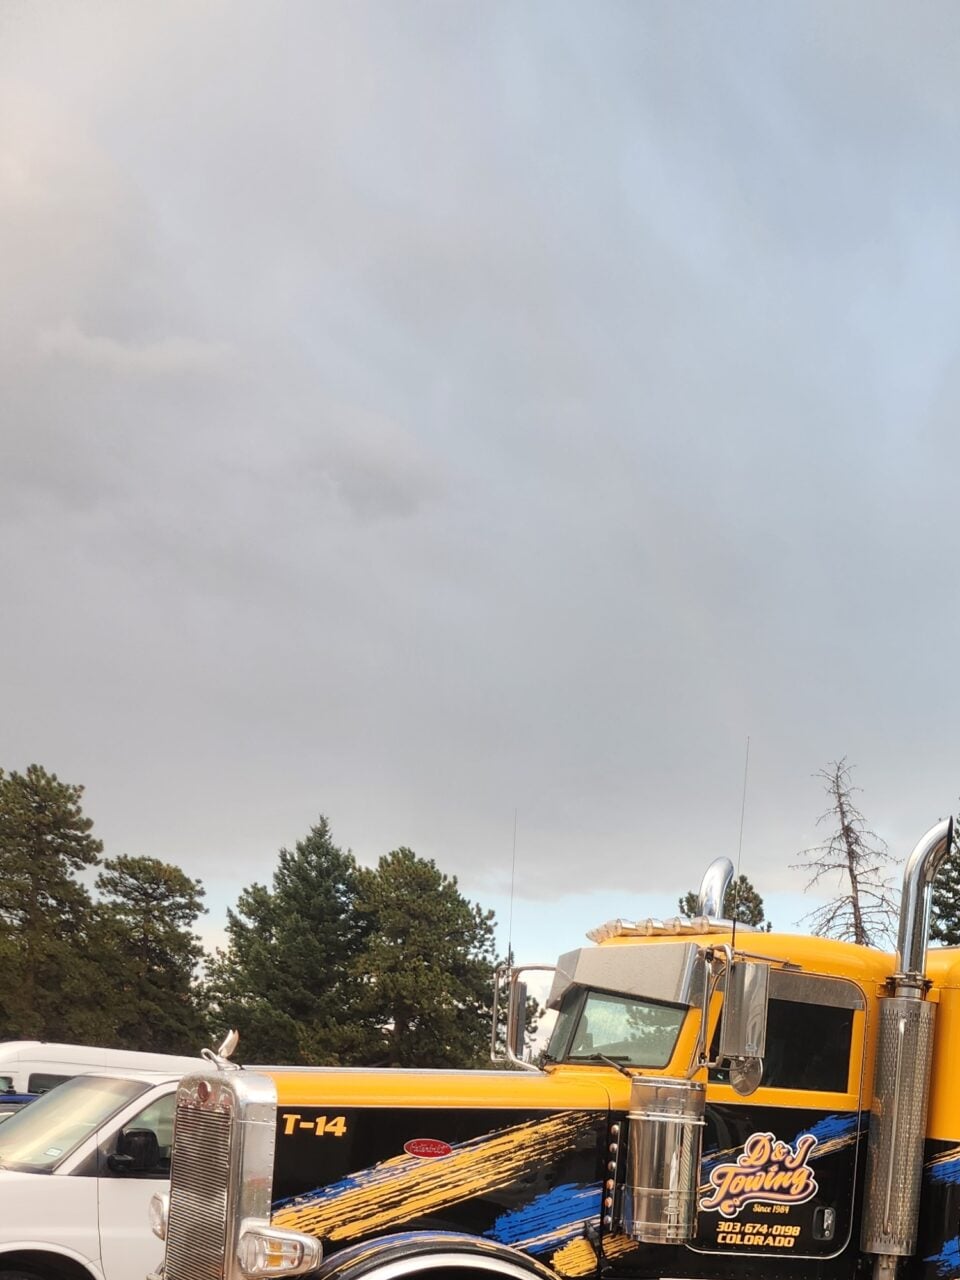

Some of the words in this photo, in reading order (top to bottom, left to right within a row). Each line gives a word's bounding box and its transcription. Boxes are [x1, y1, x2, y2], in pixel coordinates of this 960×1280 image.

[282, 1114, 347, 1137] T-14
[701, 1164, 815, 1206] Towing
[753, 1203, 771, 1213] Since
[772, 1205, 790, 1214] 1984
[717, 1233, 795, 1247] COLORADO
